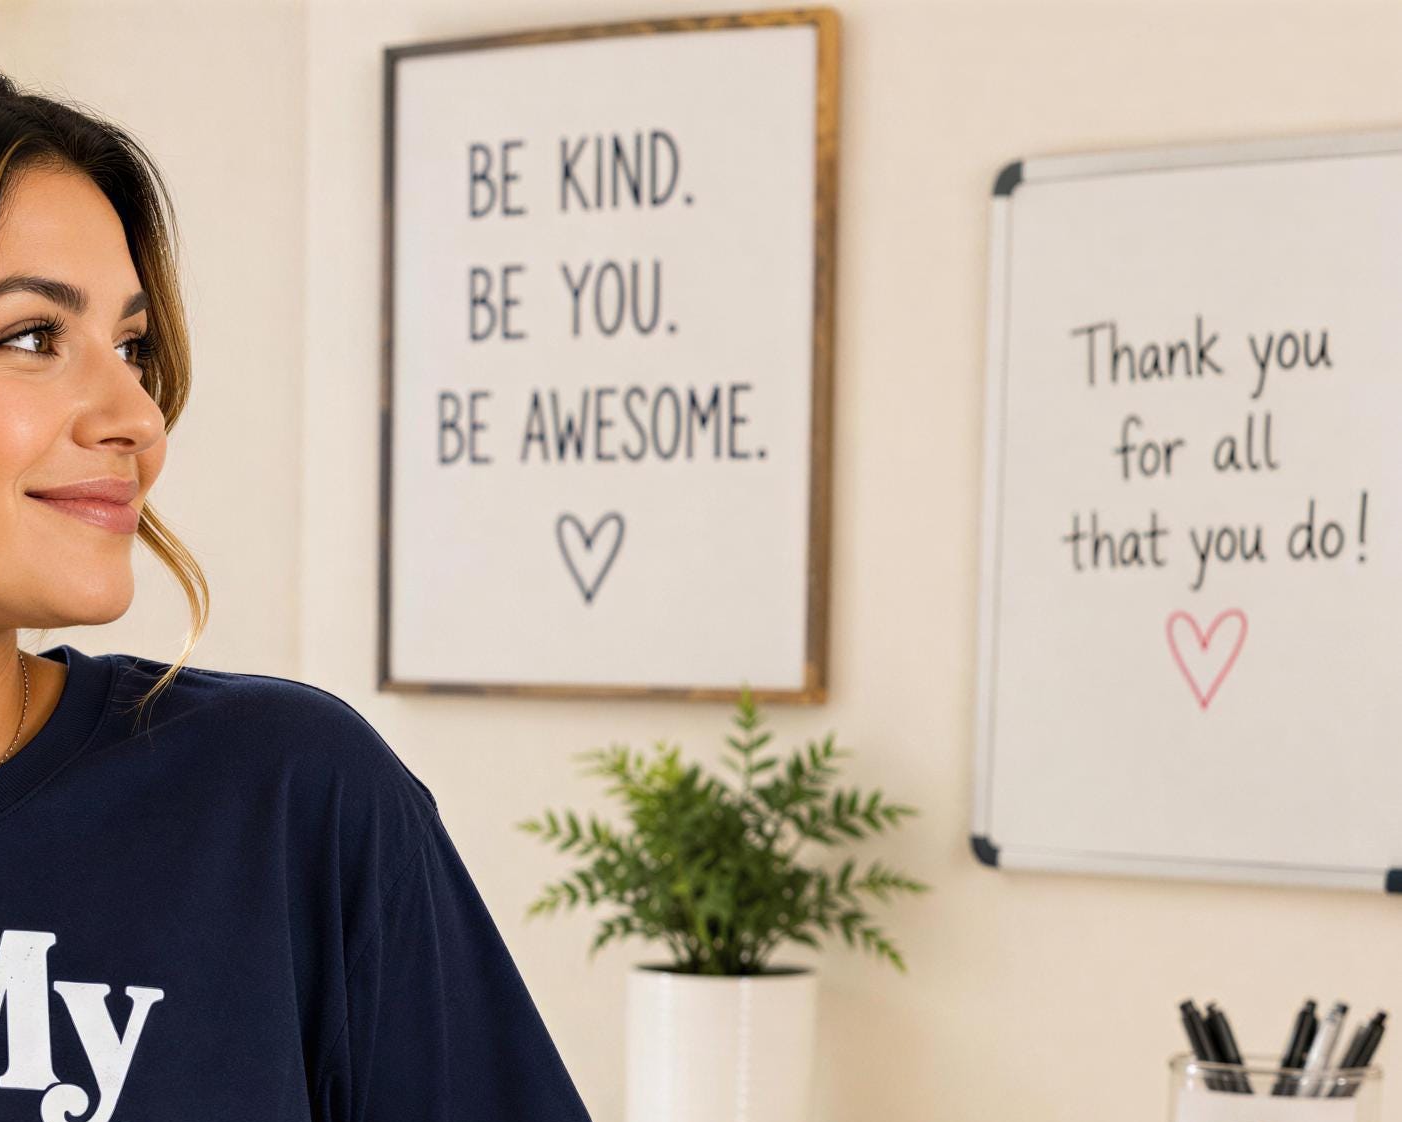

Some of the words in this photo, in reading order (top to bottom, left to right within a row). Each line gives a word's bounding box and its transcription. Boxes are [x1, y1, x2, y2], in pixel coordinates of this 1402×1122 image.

[469, 140, 525, 219] BE
[560, 130, 693, 210] KIND.
[469, 265, 525, 342] BE
[561, 260, 677, 337] YOU.
[1073, 317, 1223, 385] Thank
[1249, 331, 1332, 400] you
[438, 391, 490, 466] BE
[521, 384, 767, 462] AWESOME.
[1115, 415, 1185, 480] for
[1213, 413, 1277, 472] all
[1065, 513, 1168, 571] that
[1190, 526, 1266, 591] you
[1287, 491, 1368, 563] do!
